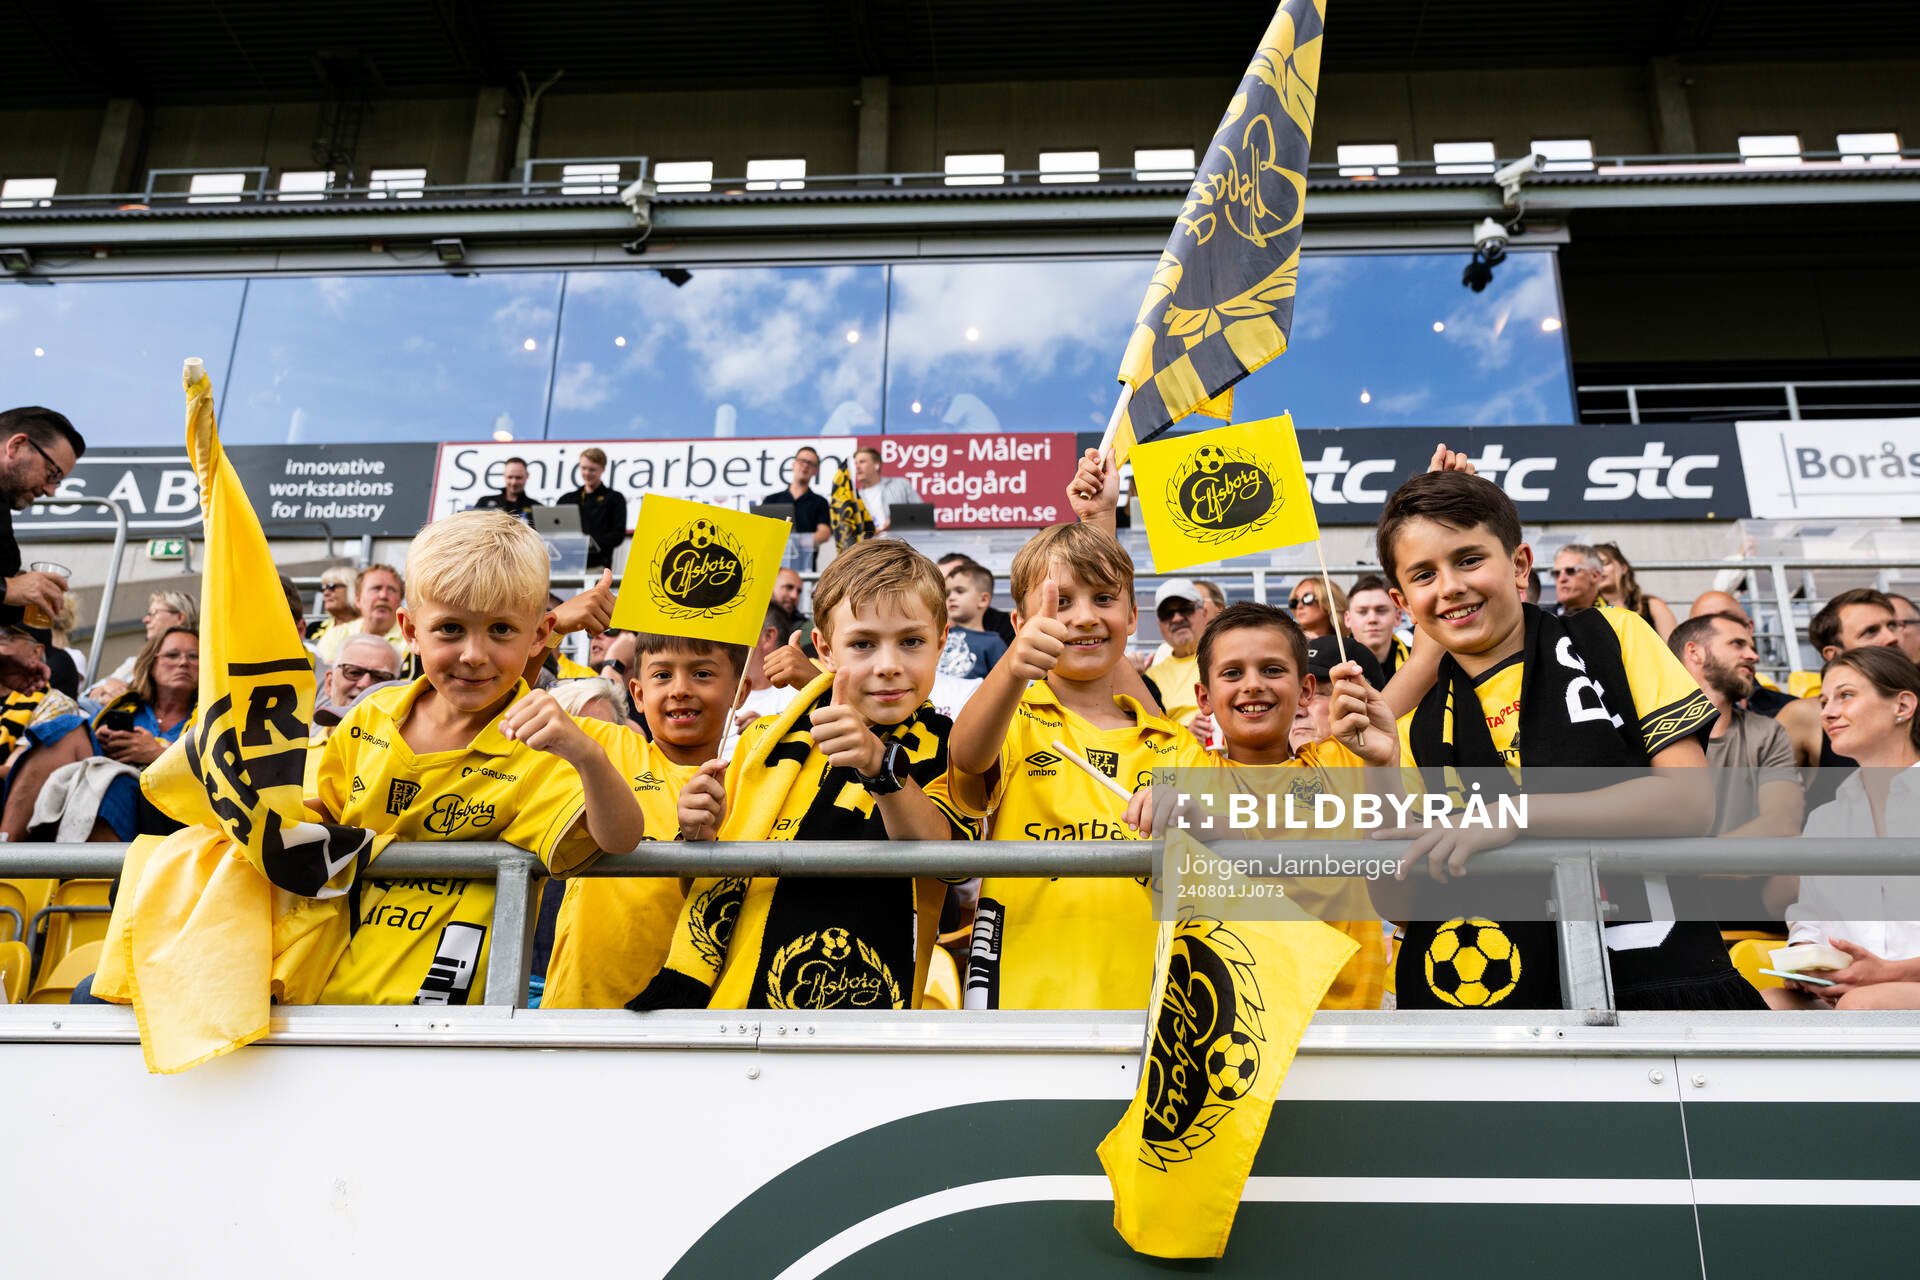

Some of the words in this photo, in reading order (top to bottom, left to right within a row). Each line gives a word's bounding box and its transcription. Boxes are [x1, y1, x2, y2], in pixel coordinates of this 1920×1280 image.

[285, 458, 386, 476] innovative
[881, 439, 949, 468] Bygg
[968, 436, 1052, 462] Måleri
[905, 469, 1027, 500] Trädgård
[1303, 446, 1396, 504] tc
[1583, 441, 1720, 500] stc
[96, 469, 200, 514] AB
[269, 480, 394, 497] workstations
[1190, 468, 1263, 525] Elfsborg
[271, 501, 302, 518] for
[304, 501, 385, 522] industry
[933, 502, 1057, 523] rarbeten.se
[663, 549, 738, 599] Elfsborg
[634, 784, 661, 792] umbro
[1028, 769, 1057, 777] umbro
[423, 793, 496, 837] Elfsborg
[785, 960, 882, 1010] Elfsborg
